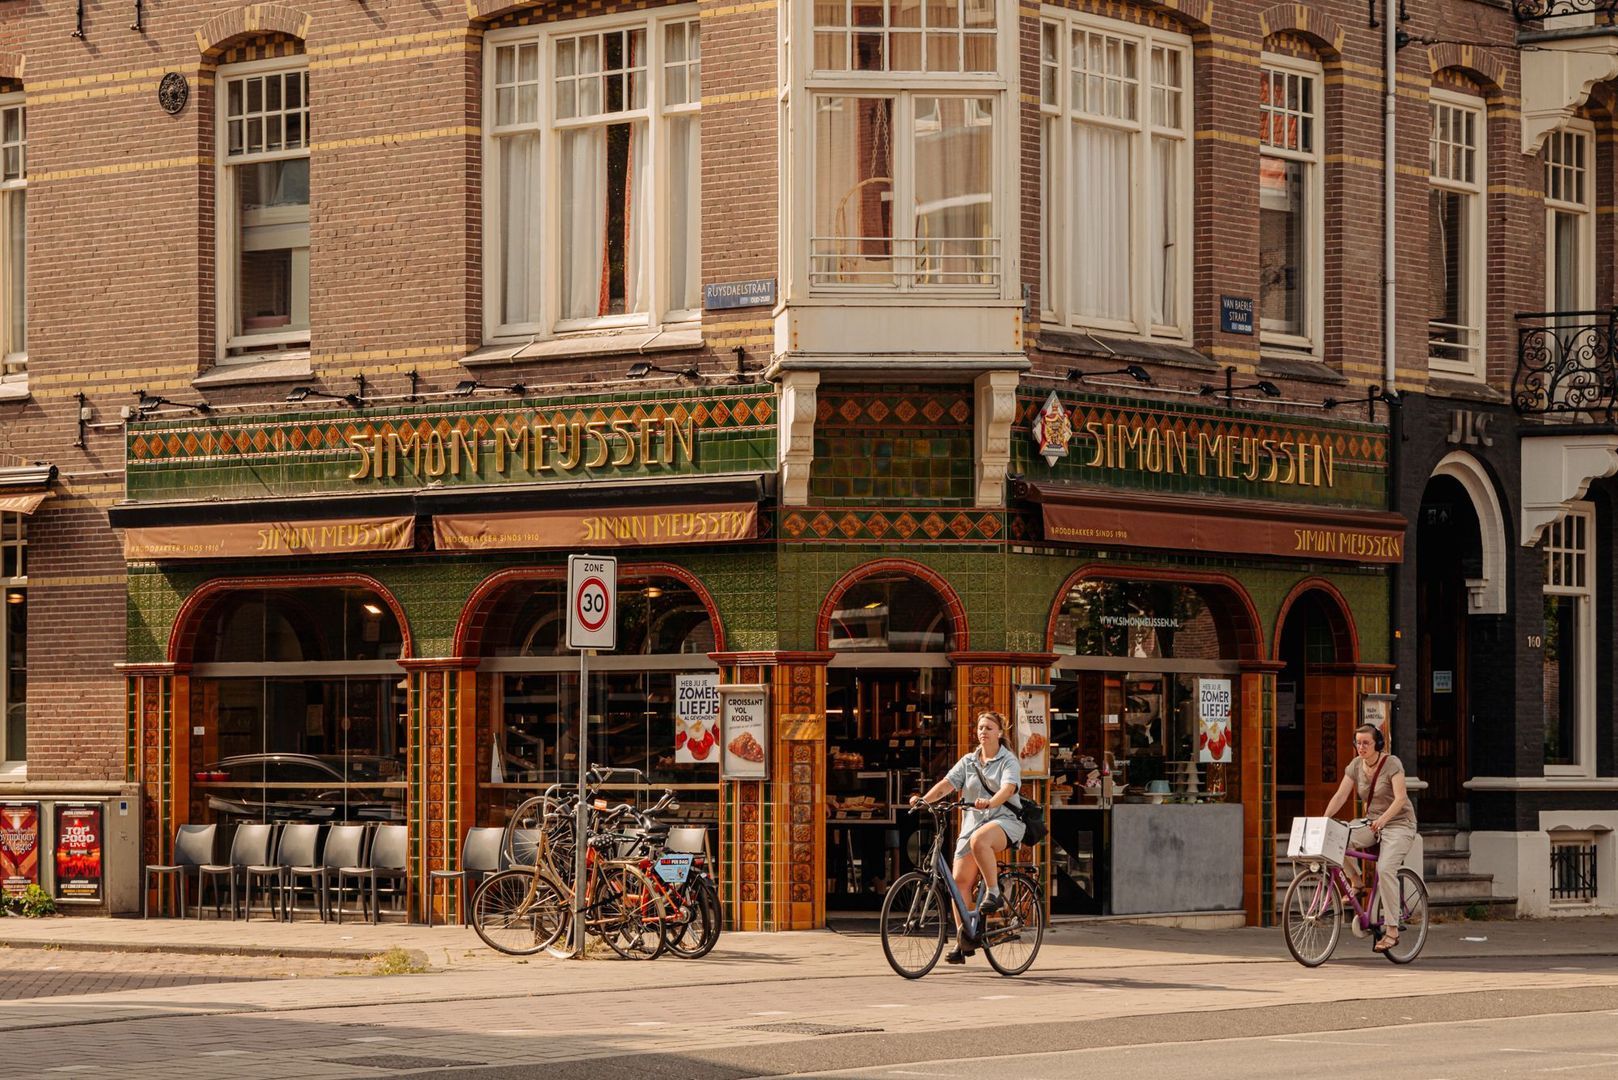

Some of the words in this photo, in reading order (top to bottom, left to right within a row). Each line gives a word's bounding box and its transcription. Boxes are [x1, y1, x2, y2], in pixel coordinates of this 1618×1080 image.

[707, 282, 771, 298] RUYSDAELSTRAAT
[1223, 298, 1234, 309] VAN
[1234, 300, 1252, 312] BAERLE
[1229, 311, 1247, 322] STRAAT
[1447, 409, 1494, 447] JLC
[349, 430, 478, 479] SIMON
[1086, 421, 1187, 475] SIMON
[582, 516, 647, 541] SIMON
[1095, 529, 1114, 538] SINDS
[257, 527, 316, 550] SIMON
[499, 534, 521, 542] SINDS
[523, 533, 539, 541] 1910
[1294, 529, 1336, 553] SIMON
[584, 563, 604, 573] ZONE
[582, 593, 604, 613] 30
[1527, 635, 1541, 648] 160
[679, 687, 719, 700] ZOMER
[1201, 690, 1229, 703] ZOMER
[680, 700, 720, 715] LIEFJE
[728, 698, 763, 706] CROISSANT
[1201, 703, 1230, 717] LIEFJE
[66, 826, 90, 835] TOP
[61, 834, 95, 843] 2000
